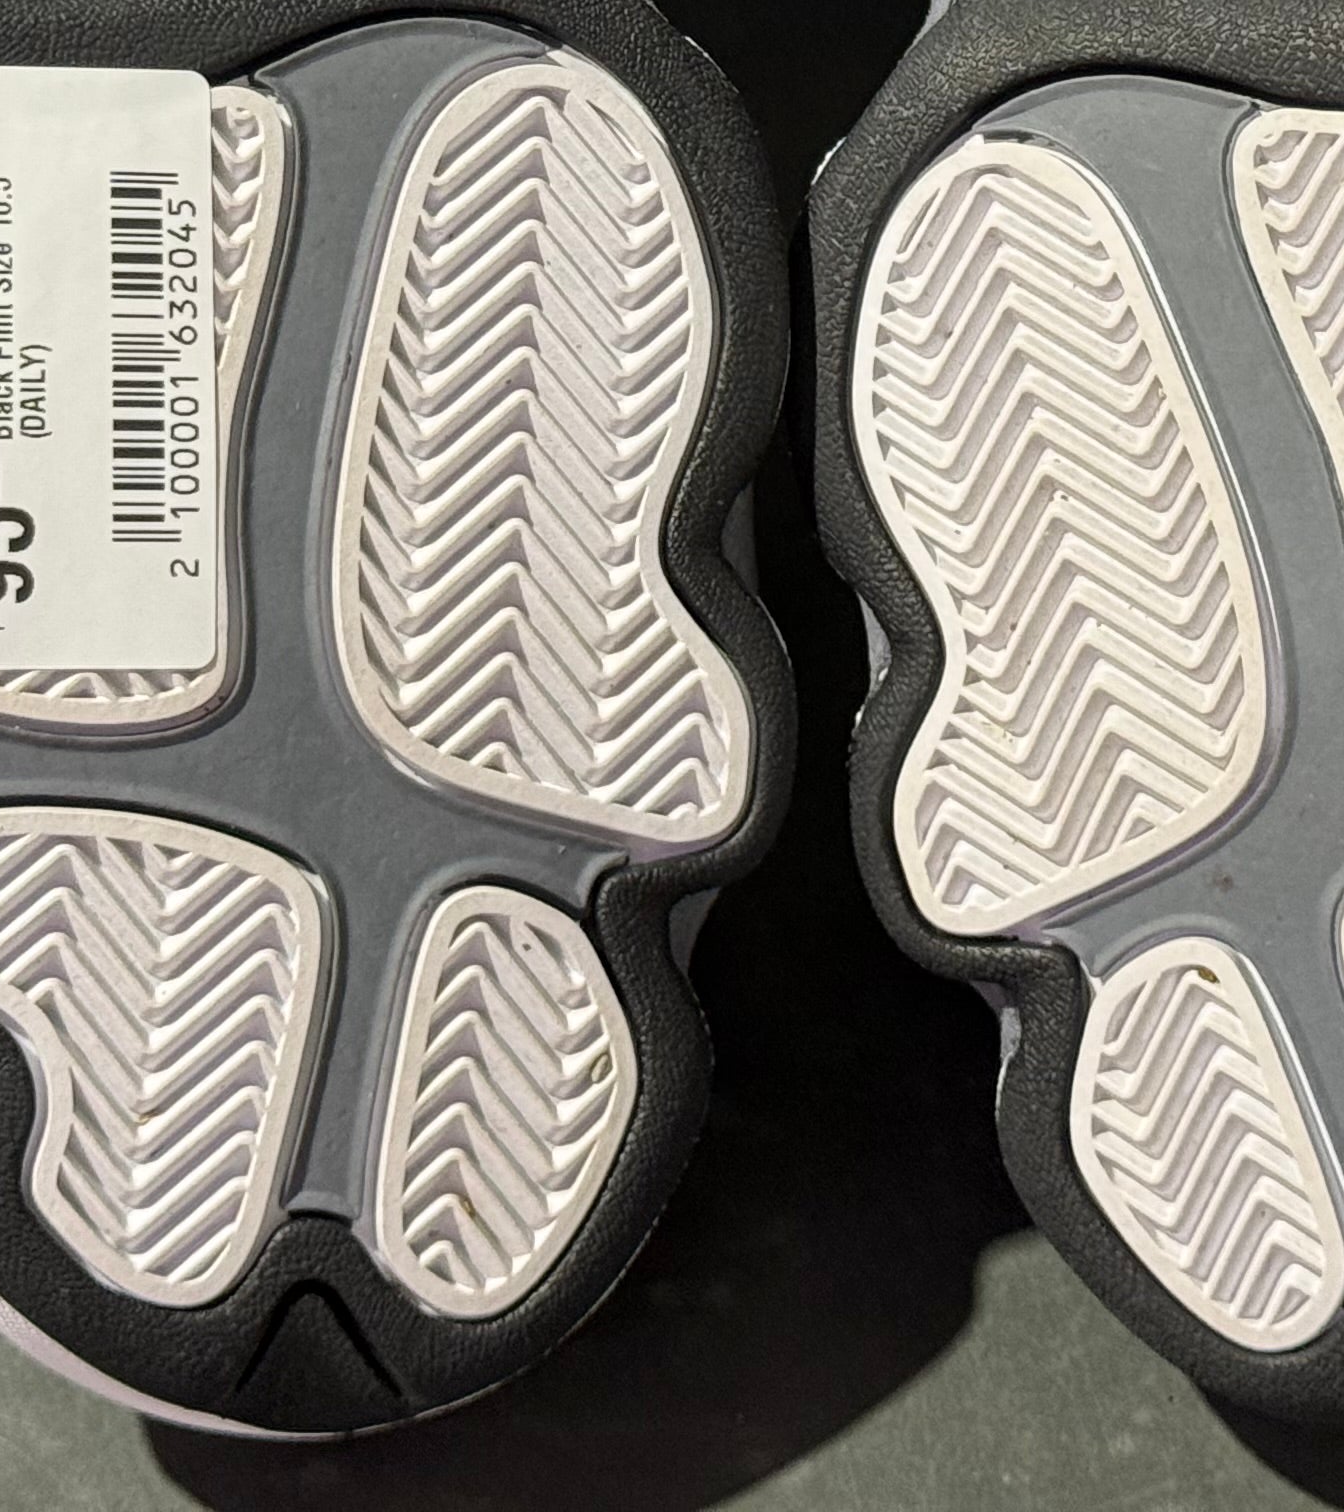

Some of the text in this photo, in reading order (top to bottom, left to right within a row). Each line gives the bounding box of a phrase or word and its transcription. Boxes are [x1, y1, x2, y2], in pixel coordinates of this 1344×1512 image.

[19, 343, 53, 439] (DAILY)
[167, 197, 201, 578] 2 100001 632045
